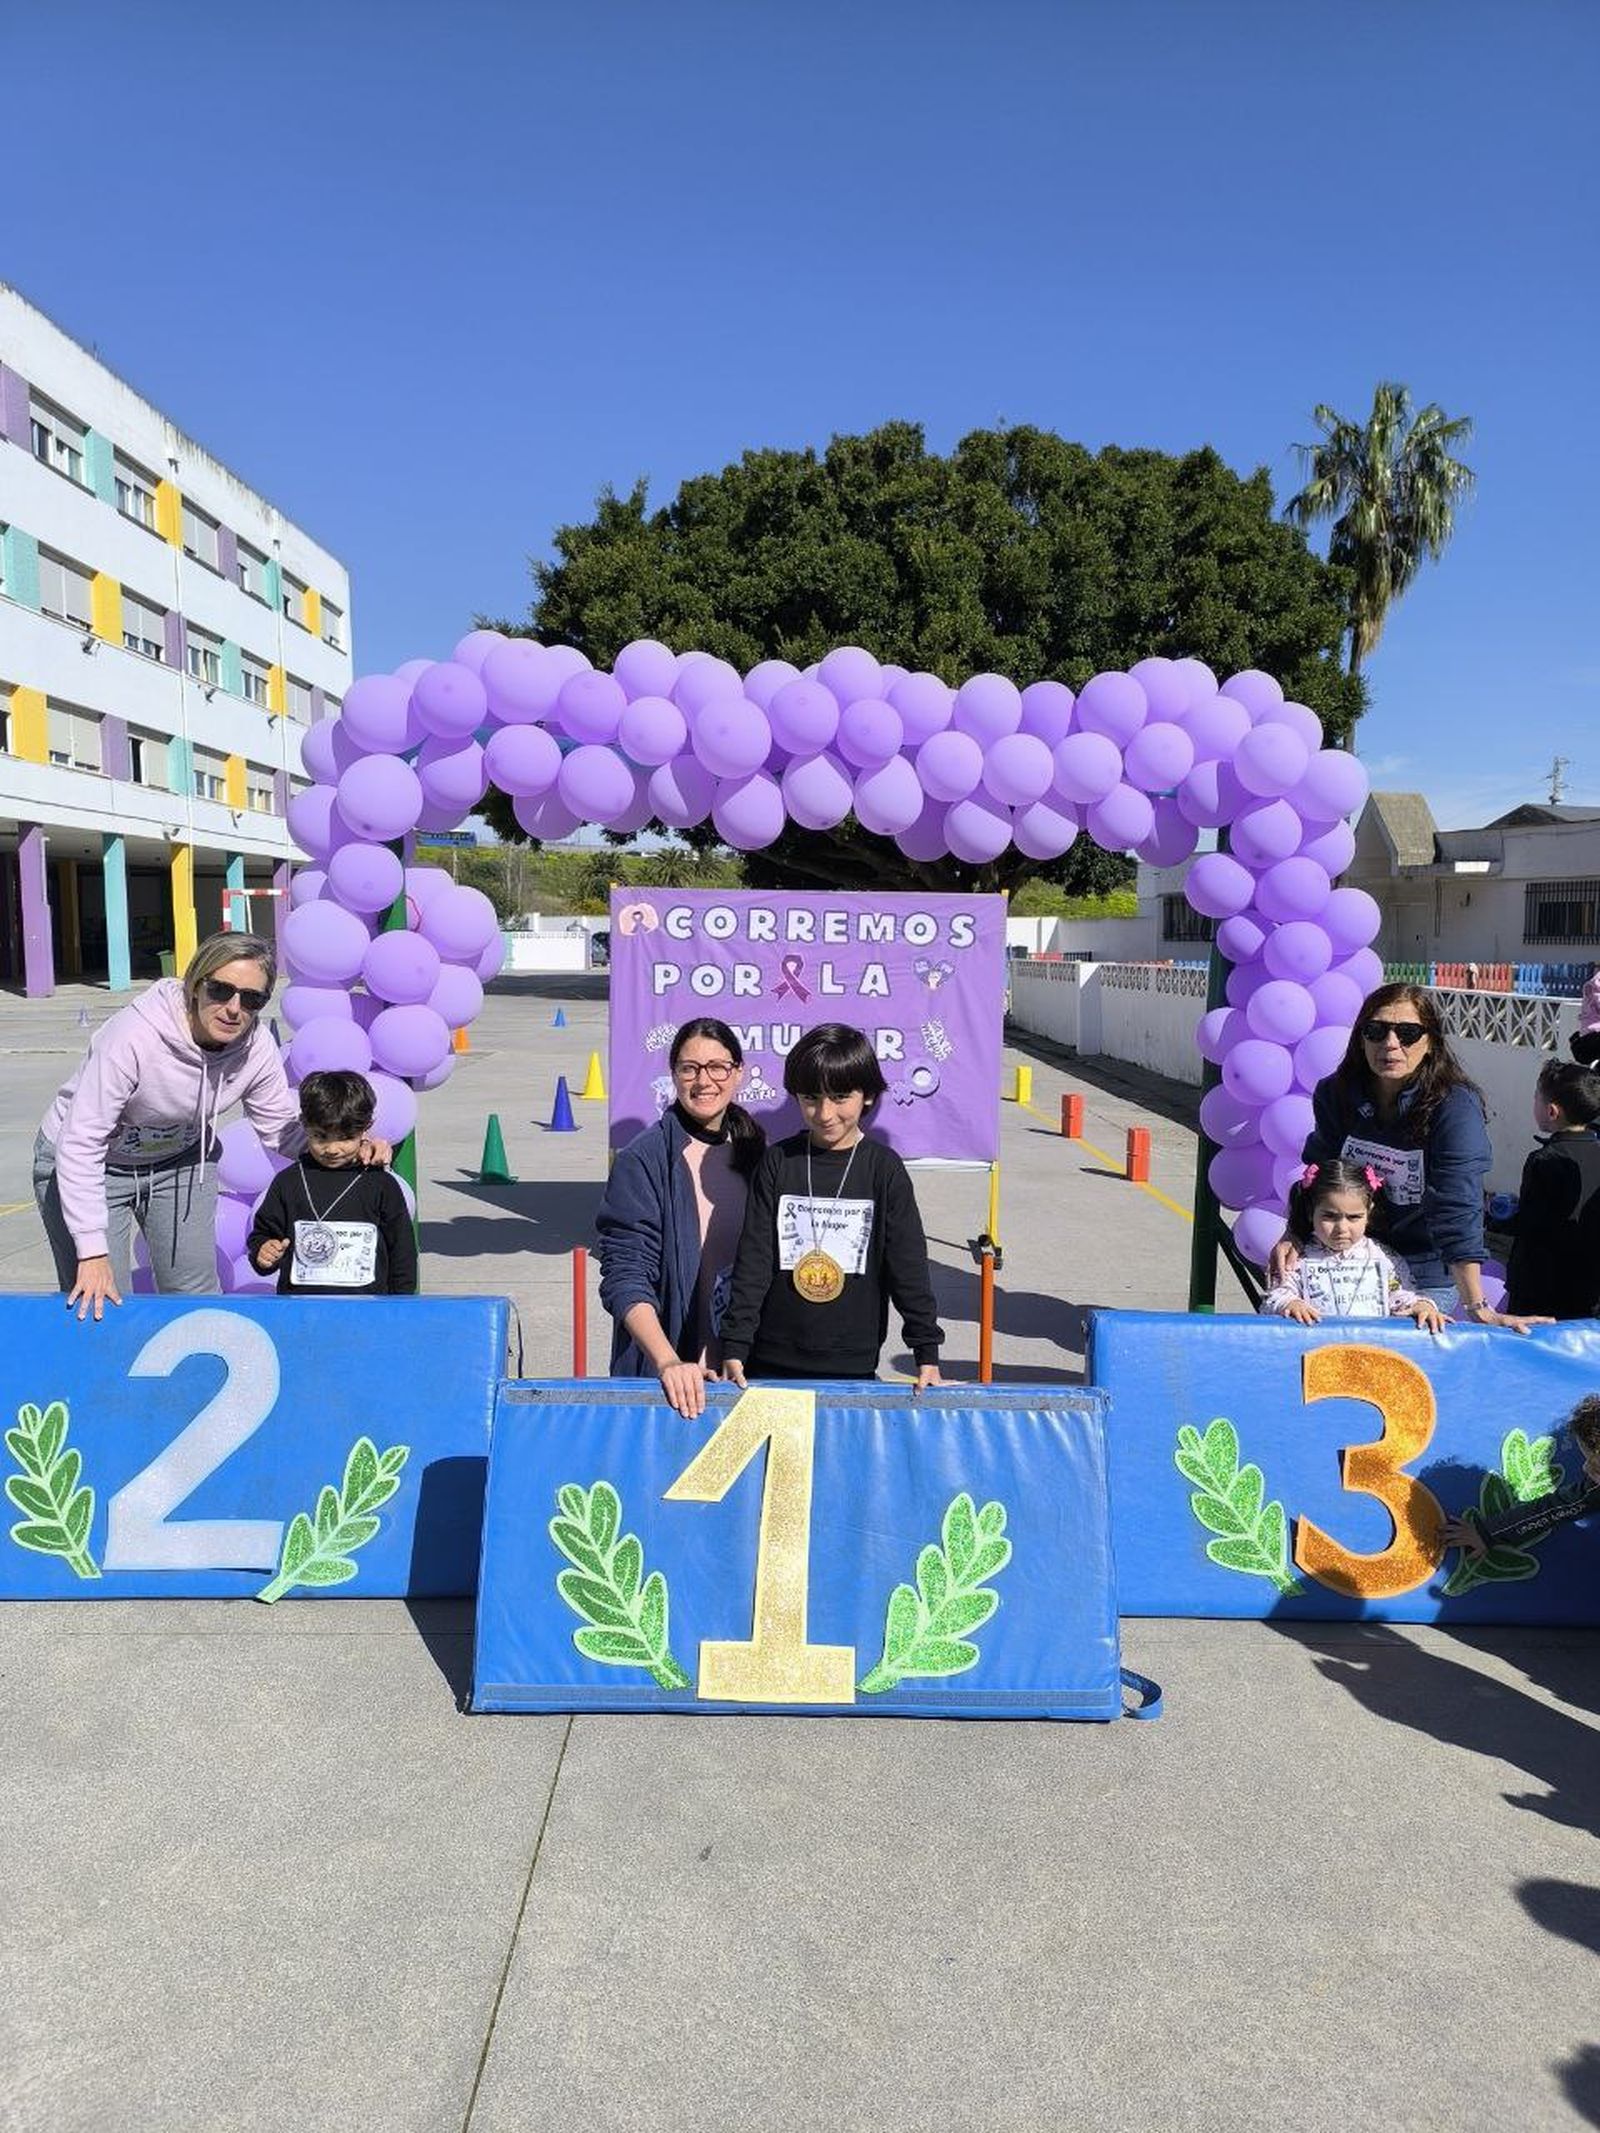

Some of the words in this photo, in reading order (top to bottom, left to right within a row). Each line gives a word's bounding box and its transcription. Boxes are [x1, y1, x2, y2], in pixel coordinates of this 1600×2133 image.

[653, 962, 763, 998] POR
[818, 961, 892, 998] LA
[664, 906, 977, 948] CORREMOS
[728, 1022, 905, 1062] MUR
[103, 1309, 285, 1571] 2
[1297, 1344, 1448, 1598] 3
[662, 1387, 856, 1704] 1
